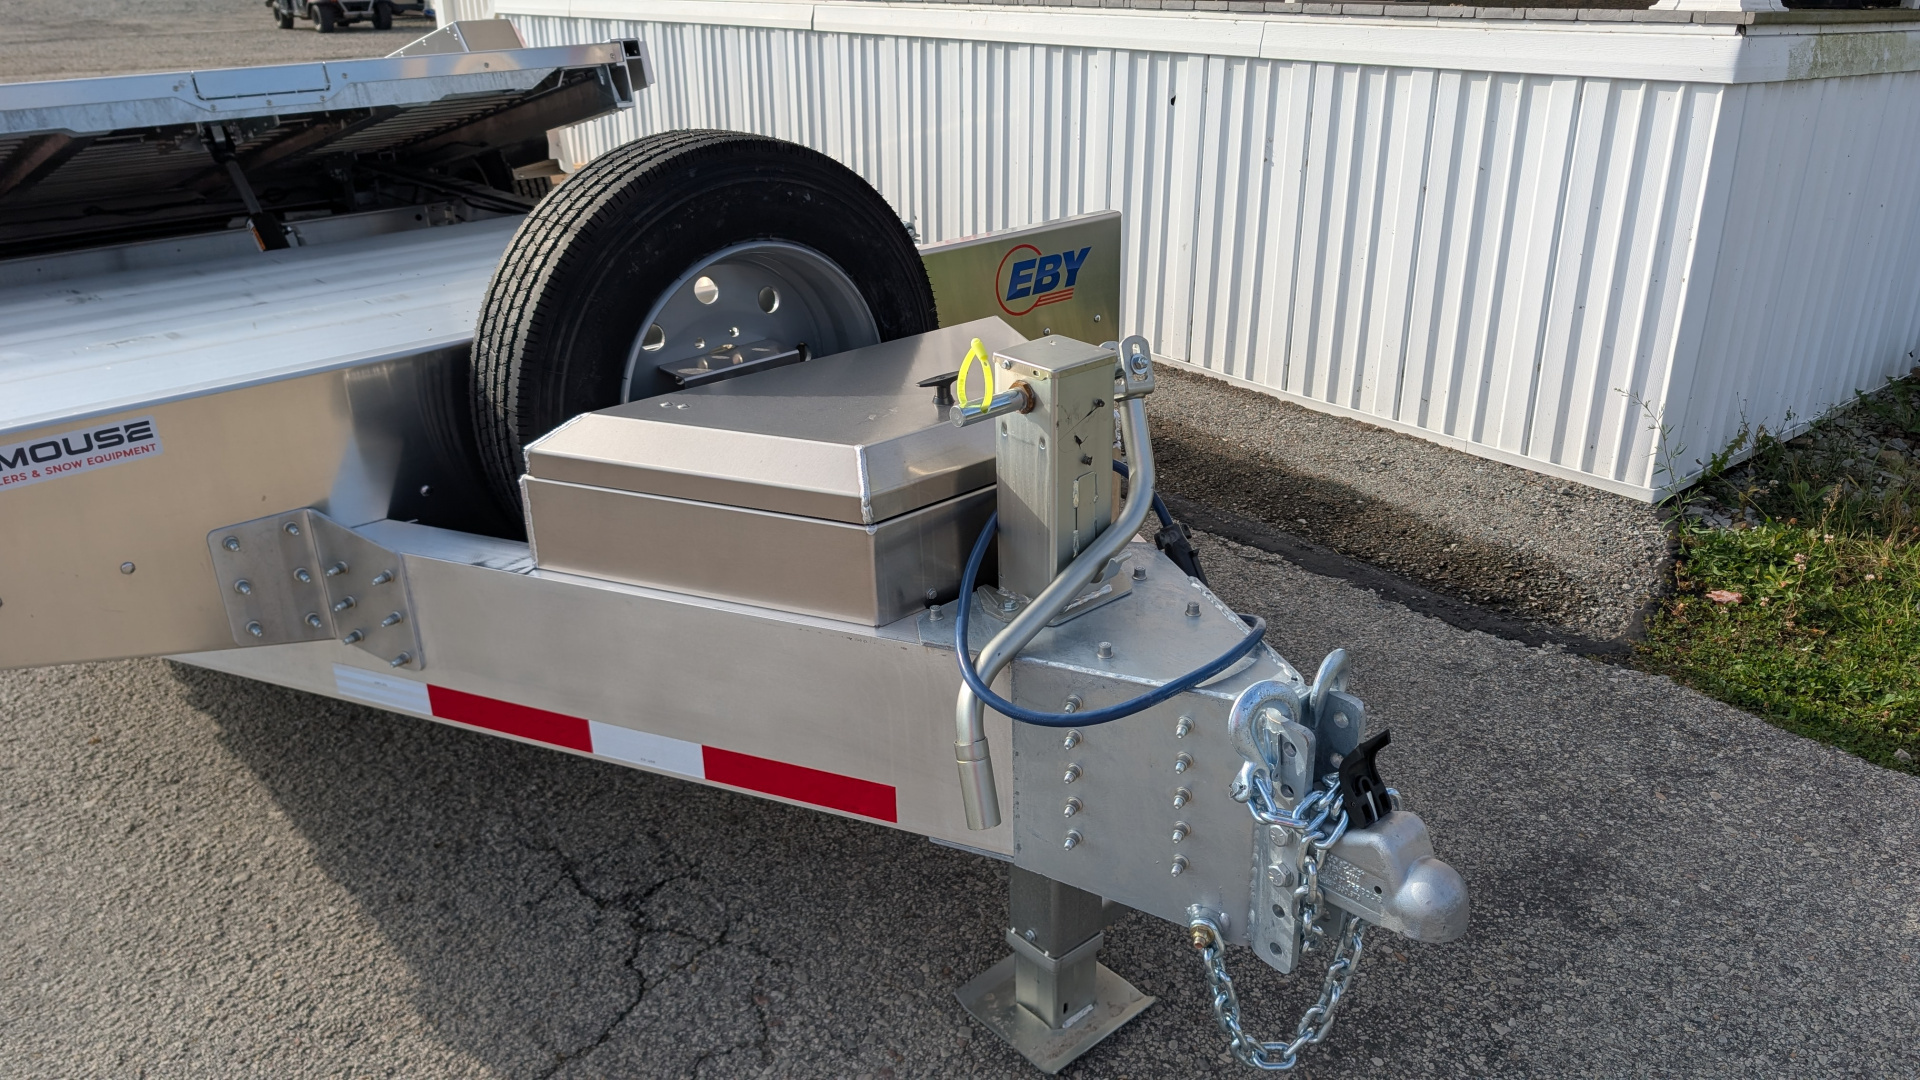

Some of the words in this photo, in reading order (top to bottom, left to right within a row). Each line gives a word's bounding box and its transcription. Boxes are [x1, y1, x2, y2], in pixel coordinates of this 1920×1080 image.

[1006, 246, 1092, 301] EBY
[0, 420, 154, 471] MOUSE
[31, 470, 41, 478] &
[45, 459, 83, 475] SNOW
[87, 443, 157, 466] EQUIPMENT
